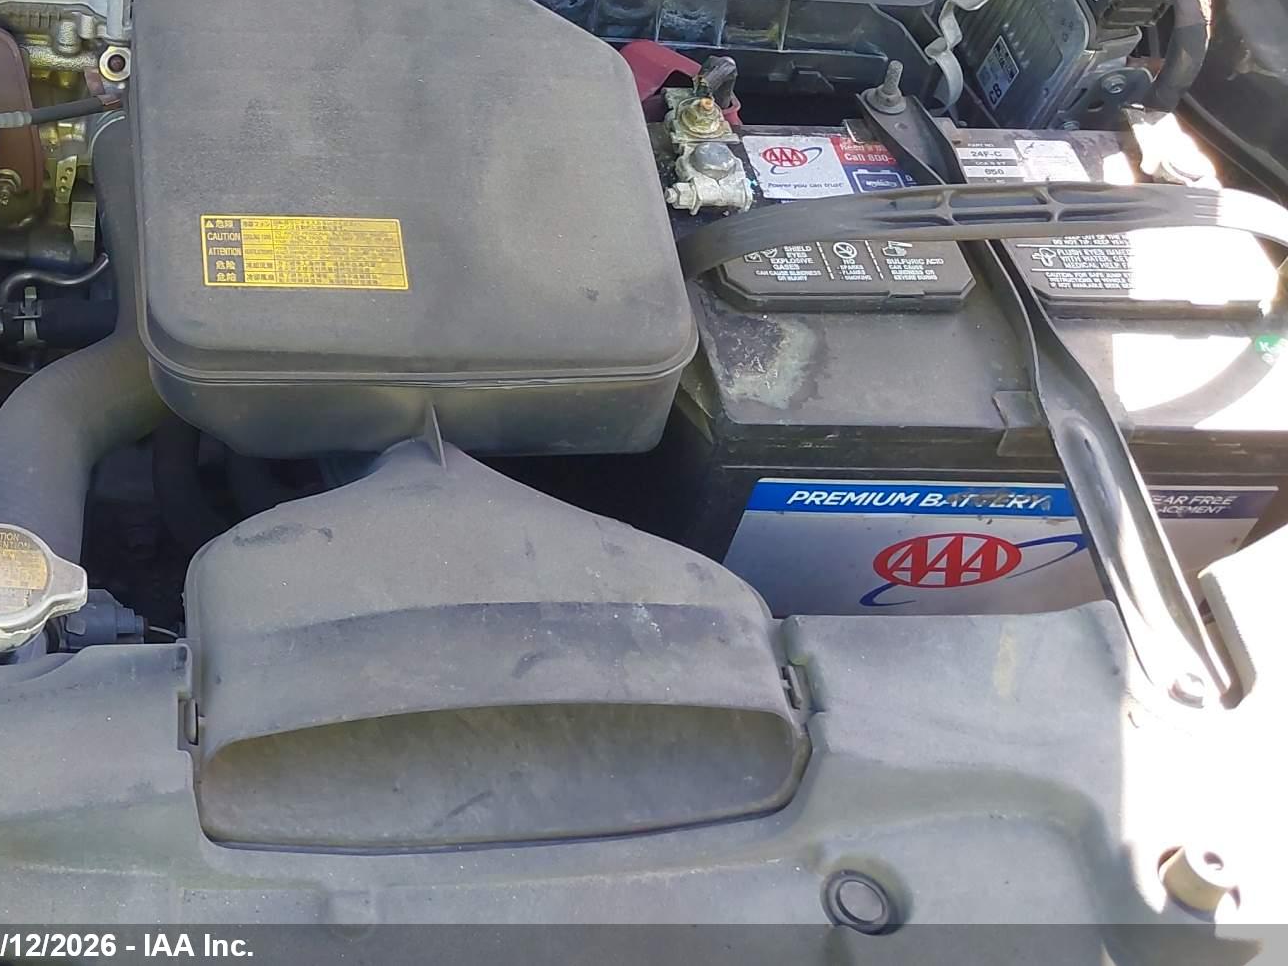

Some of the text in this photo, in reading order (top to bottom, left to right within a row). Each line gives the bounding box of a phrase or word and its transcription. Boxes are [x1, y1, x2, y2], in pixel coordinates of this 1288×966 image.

[762, 146, 808, 168] AAA
[207, 233, 241, 241] CAUTION
[208, 247, 242, 255] ATTENTION
[786, 490, 1051, 510] PREMIUM BATERY
[1152, 495, 1238, 505] EAR FREE
[1157, 505, 1226, 514] ACEMENT
[876, 534, 1020, 588] AAA
